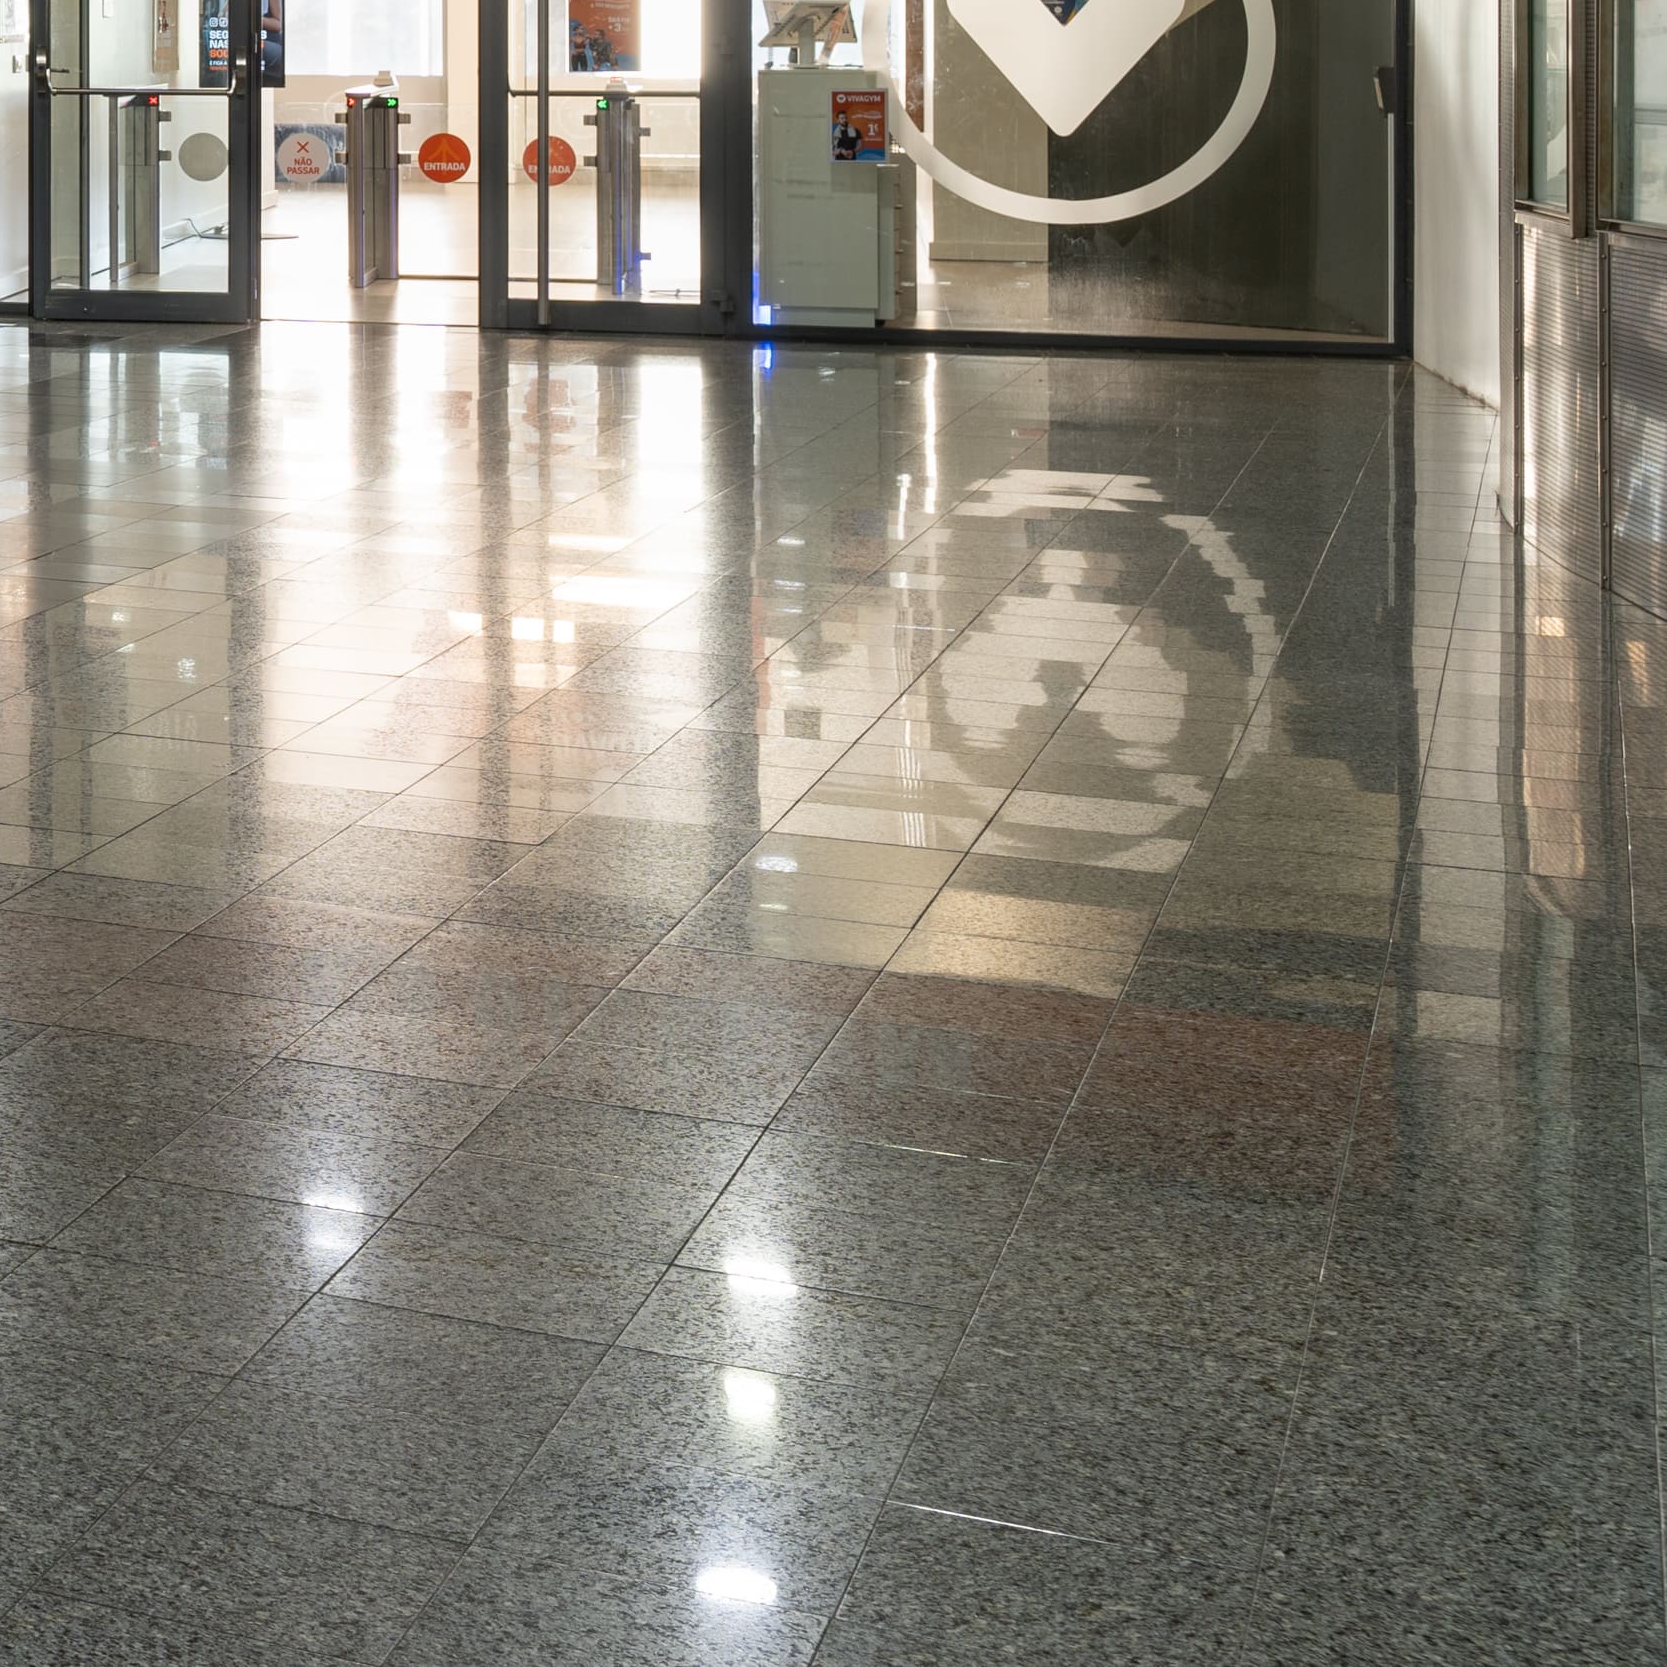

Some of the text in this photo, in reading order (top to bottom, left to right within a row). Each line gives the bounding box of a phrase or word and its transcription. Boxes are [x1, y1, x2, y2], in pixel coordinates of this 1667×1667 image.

[294, 156, 313, 166] NÃO
[286, 166, 320, 175] PASSAR
[423, 161, 466, 172] ENTRADA
[527, 164, 571, 175] ENRADA
